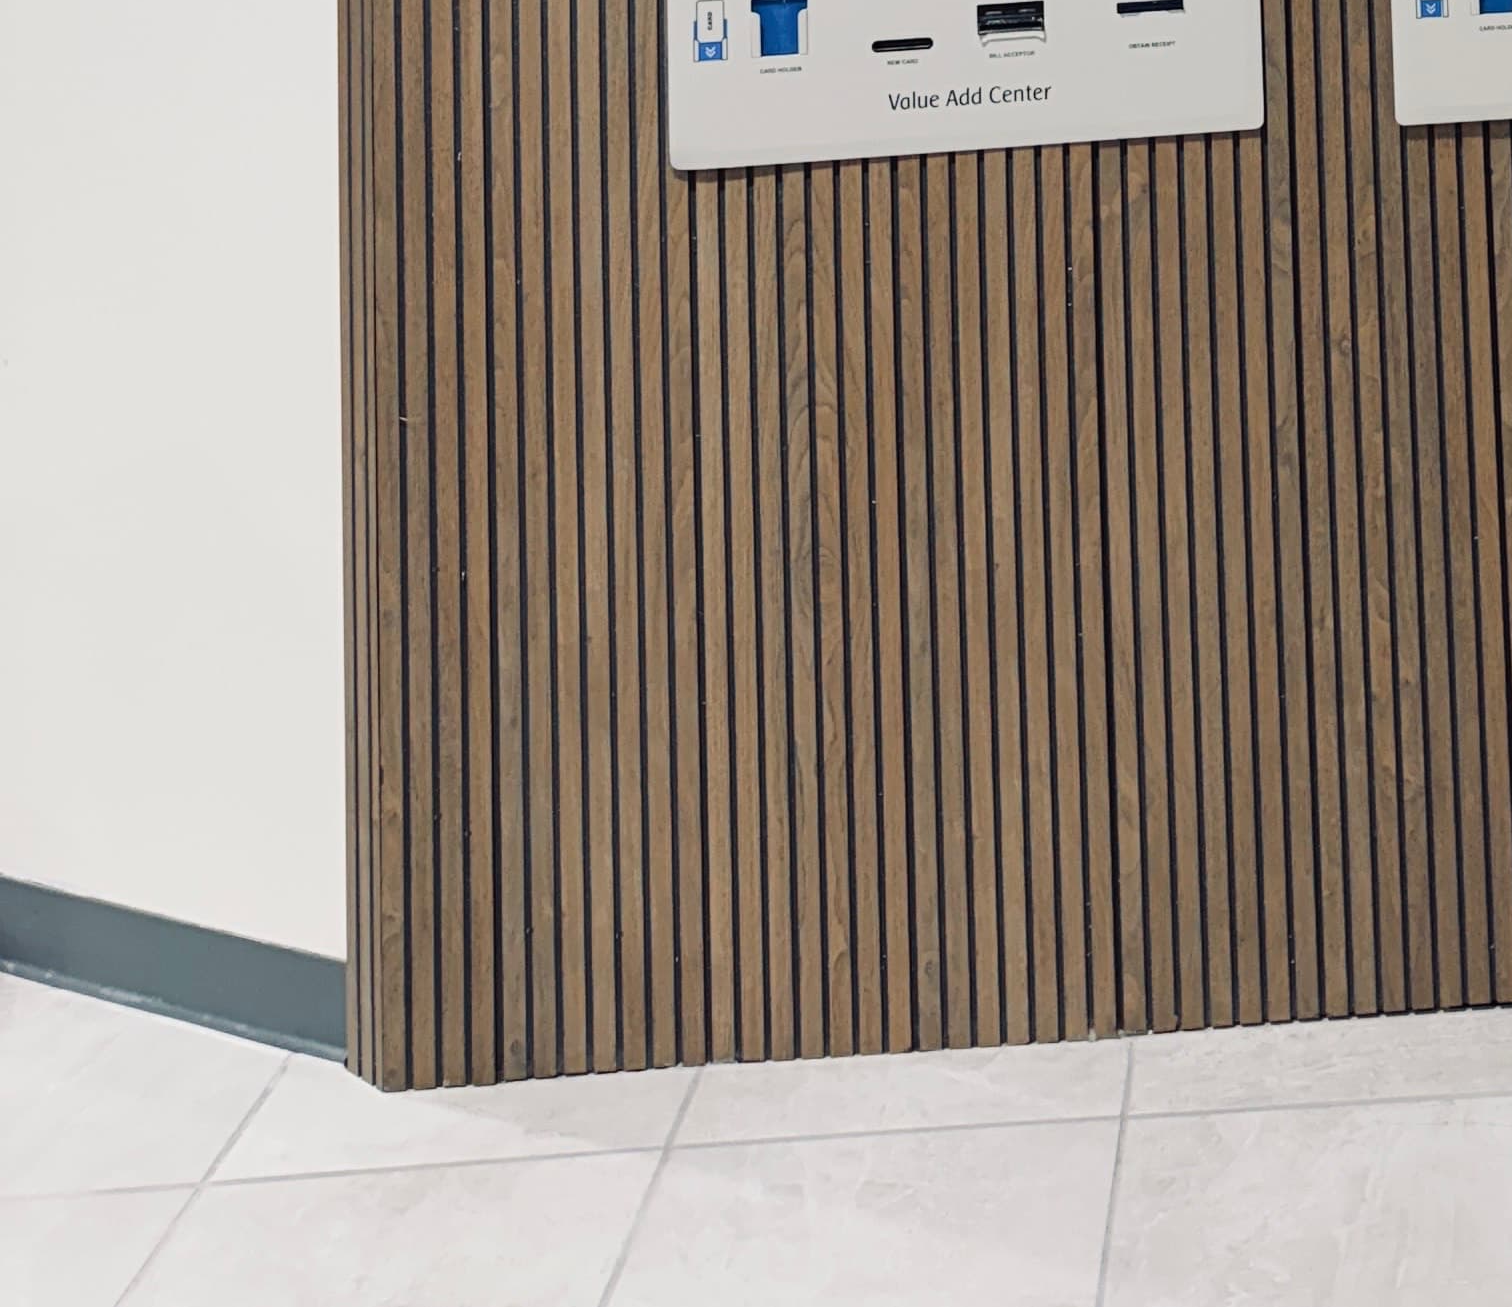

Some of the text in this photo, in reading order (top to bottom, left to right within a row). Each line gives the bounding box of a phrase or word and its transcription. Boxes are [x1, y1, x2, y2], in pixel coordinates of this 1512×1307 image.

[888, 84, 1052, 111] Value Add Center
